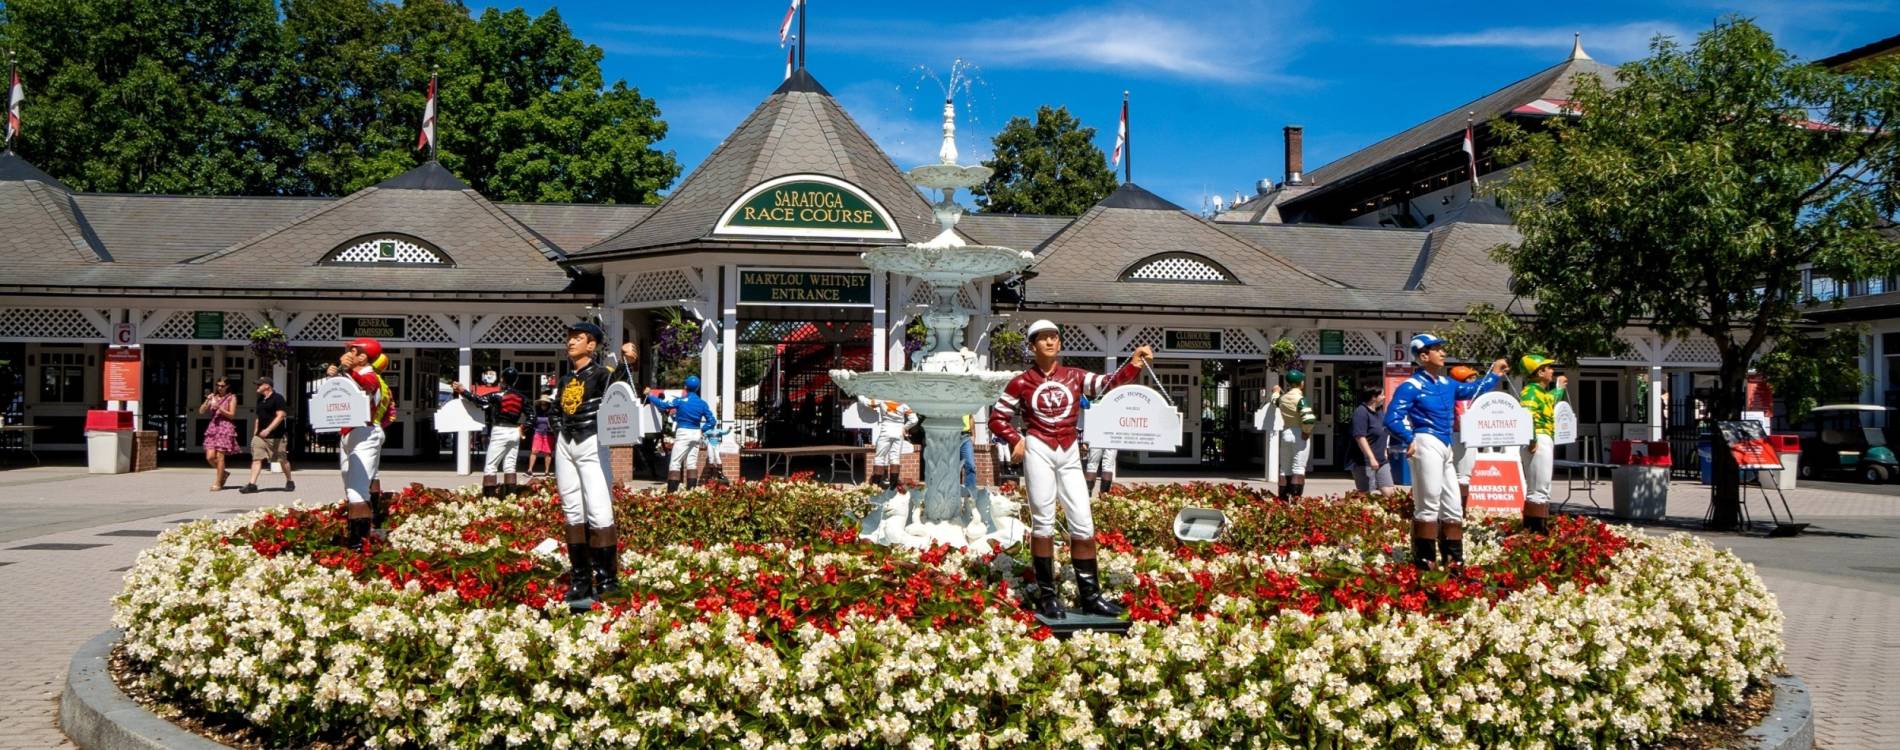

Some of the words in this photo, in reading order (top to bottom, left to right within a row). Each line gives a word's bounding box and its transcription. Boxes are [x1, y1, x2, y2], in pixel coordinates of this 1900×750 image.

[775, 190, 843, 208] SARATOGA
[744, 207, 794, 221] RACE
[800, 208, 873, 223] COURSE
[382, 244, 392, 257] C
[744, 273, 804, 285] MARYLOU
[809, 275, 867, 287] WHITNEY
[771, 288, 840, 300] ENTRANCE
[358, 318, 389, 327] GENERAL
[118, 329, 131, 343] C
[353, 328, 394, 337] ADMISSIONS
[1394, 349, 1405, 361] D
[1119, 416, 1149, 428] GUNITE
[1478, 419, 1517, 428] MALATHAAT
[1469, 484, 1506, 492] REAKFAST
